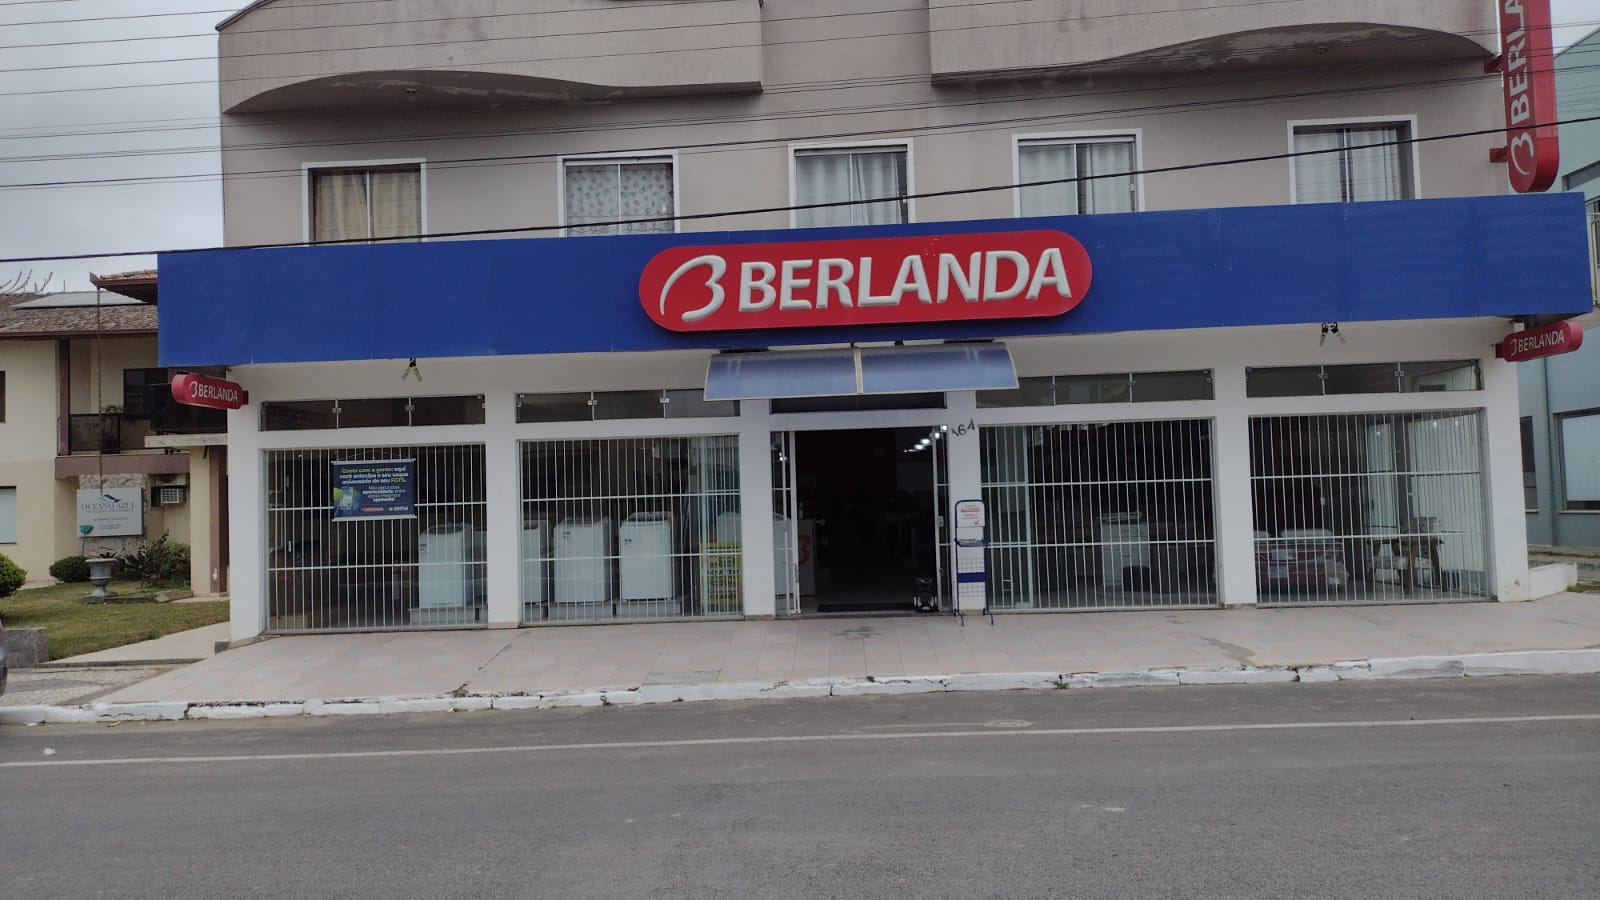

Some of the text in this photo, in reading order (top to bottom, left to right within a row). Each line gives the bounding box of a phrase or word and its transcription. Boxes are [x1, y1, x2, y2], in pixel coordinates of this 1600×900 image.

[739, 247, 1072, 312] BERLANDA
[1518, 329, 1565, 352] BERLANDA
[198, 383, 239, 402] BERLANDA
